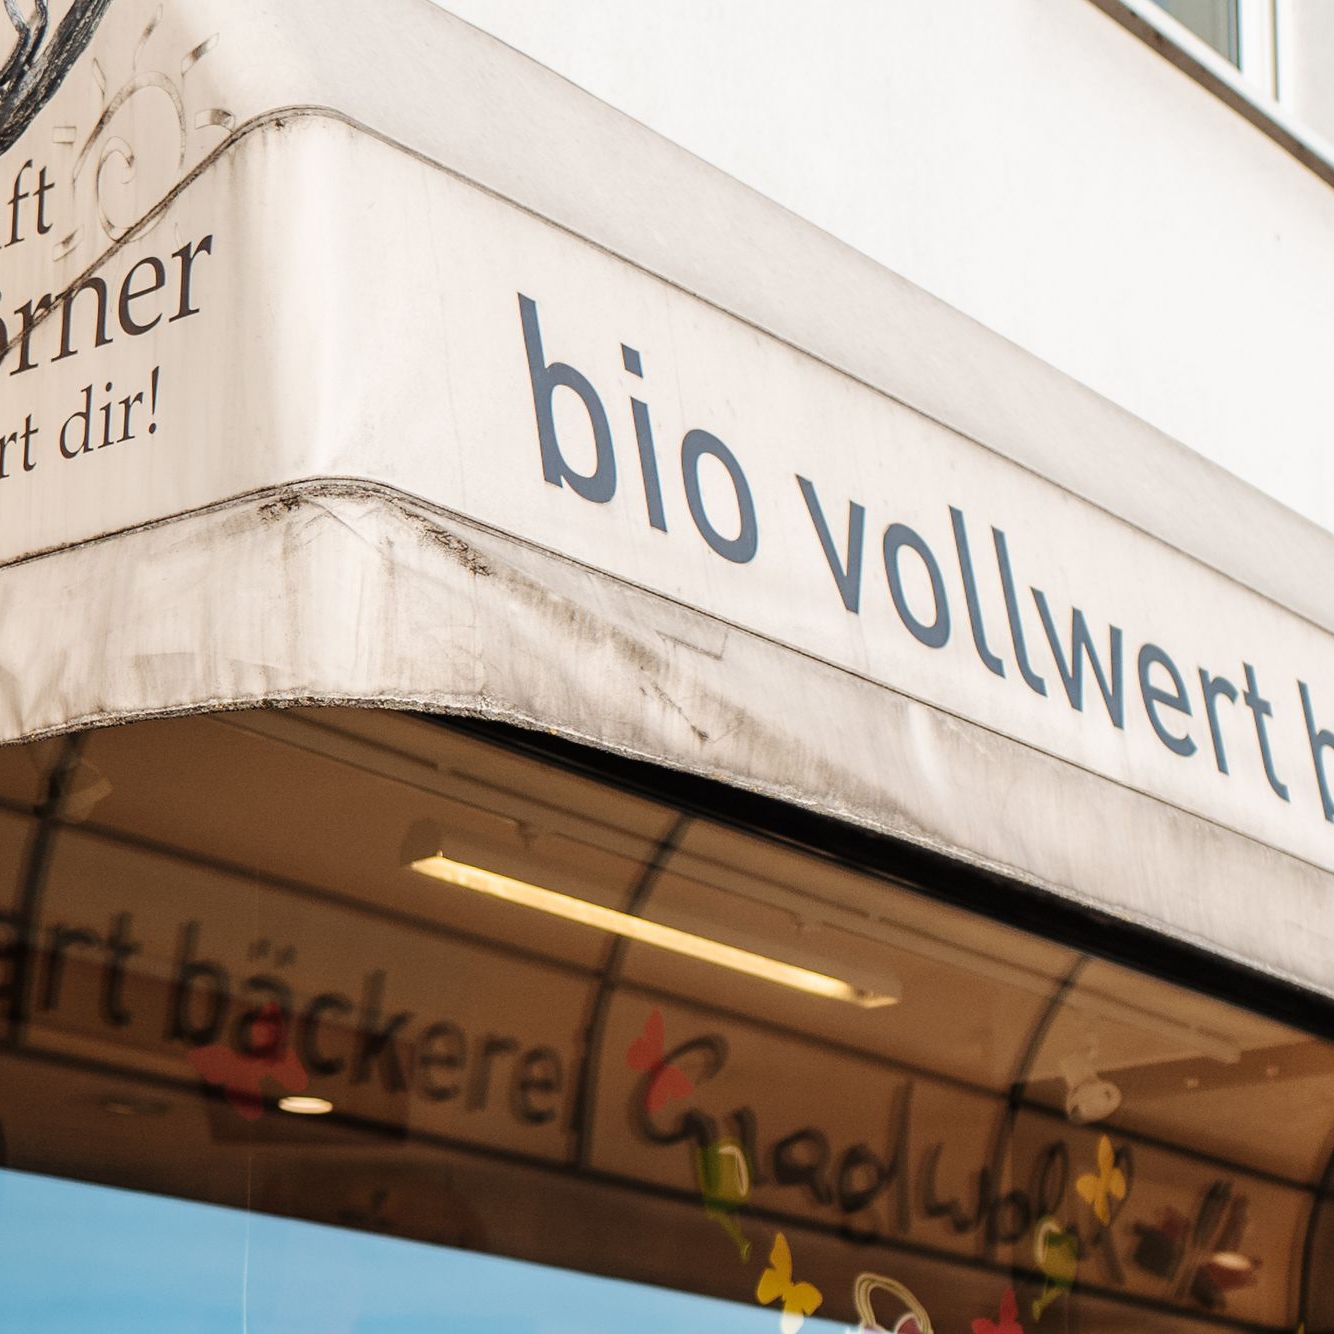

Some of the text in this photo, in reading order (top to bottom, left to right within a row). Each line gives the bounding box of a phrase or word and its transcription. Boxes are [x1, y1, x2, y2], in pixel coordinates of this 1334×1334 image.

[58, 366, 162, 461] dir!
[517, 292, 759, 565] bio
[795, 474, 1291, 803] vollwert
